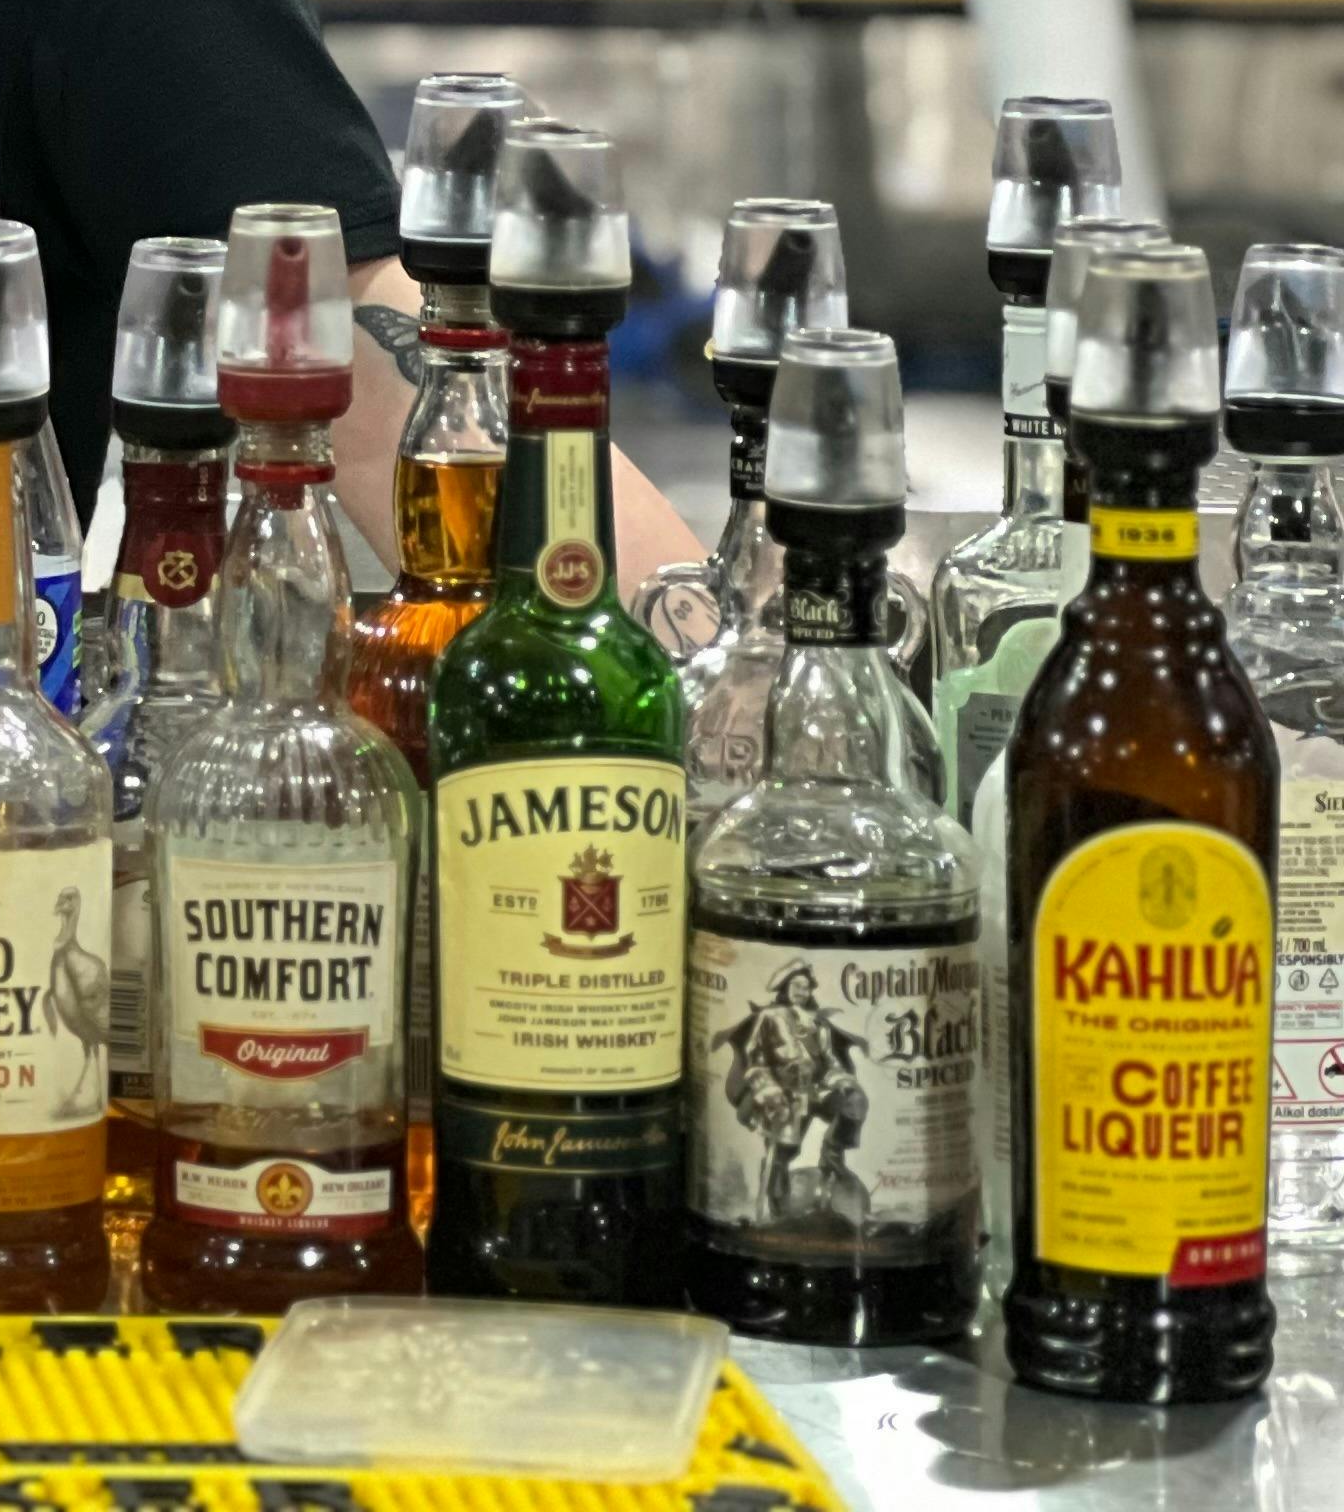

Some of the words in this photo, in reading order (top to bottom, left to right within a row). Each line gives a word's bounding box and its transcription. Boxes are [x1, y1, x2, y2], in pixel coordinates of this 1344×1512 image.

[1012, 419, 1049, 434] WHITE
[459, 785, 682, 847] JAMESON
[184, 898, 385, 947] SOUTHERN
[1277, 954, 1344, 966] ESPONSIBLY
[195, 951, 372, 1002] COMFORT
[498, 969, 571, 989] TRIPLE
[578, 969, 666, 989] DISTILLED
[840, 958, 930, 1007] Captain
[1064, 1009, 1119, 1030] THE
[1128, 1016, 1254, 1034] ORIGINAL
[236, 1039, 330, 1069] Original
[513, 1031, 569, 1049] IRISH
[576, 1030, 658, 1049] WHISKEY
[1112, 1056, 1254, 1109] COFFEE
[1274, 1106, 1305, 1118] Alkol
[1062, 1103, 1245, 1160] LIQUEUR
